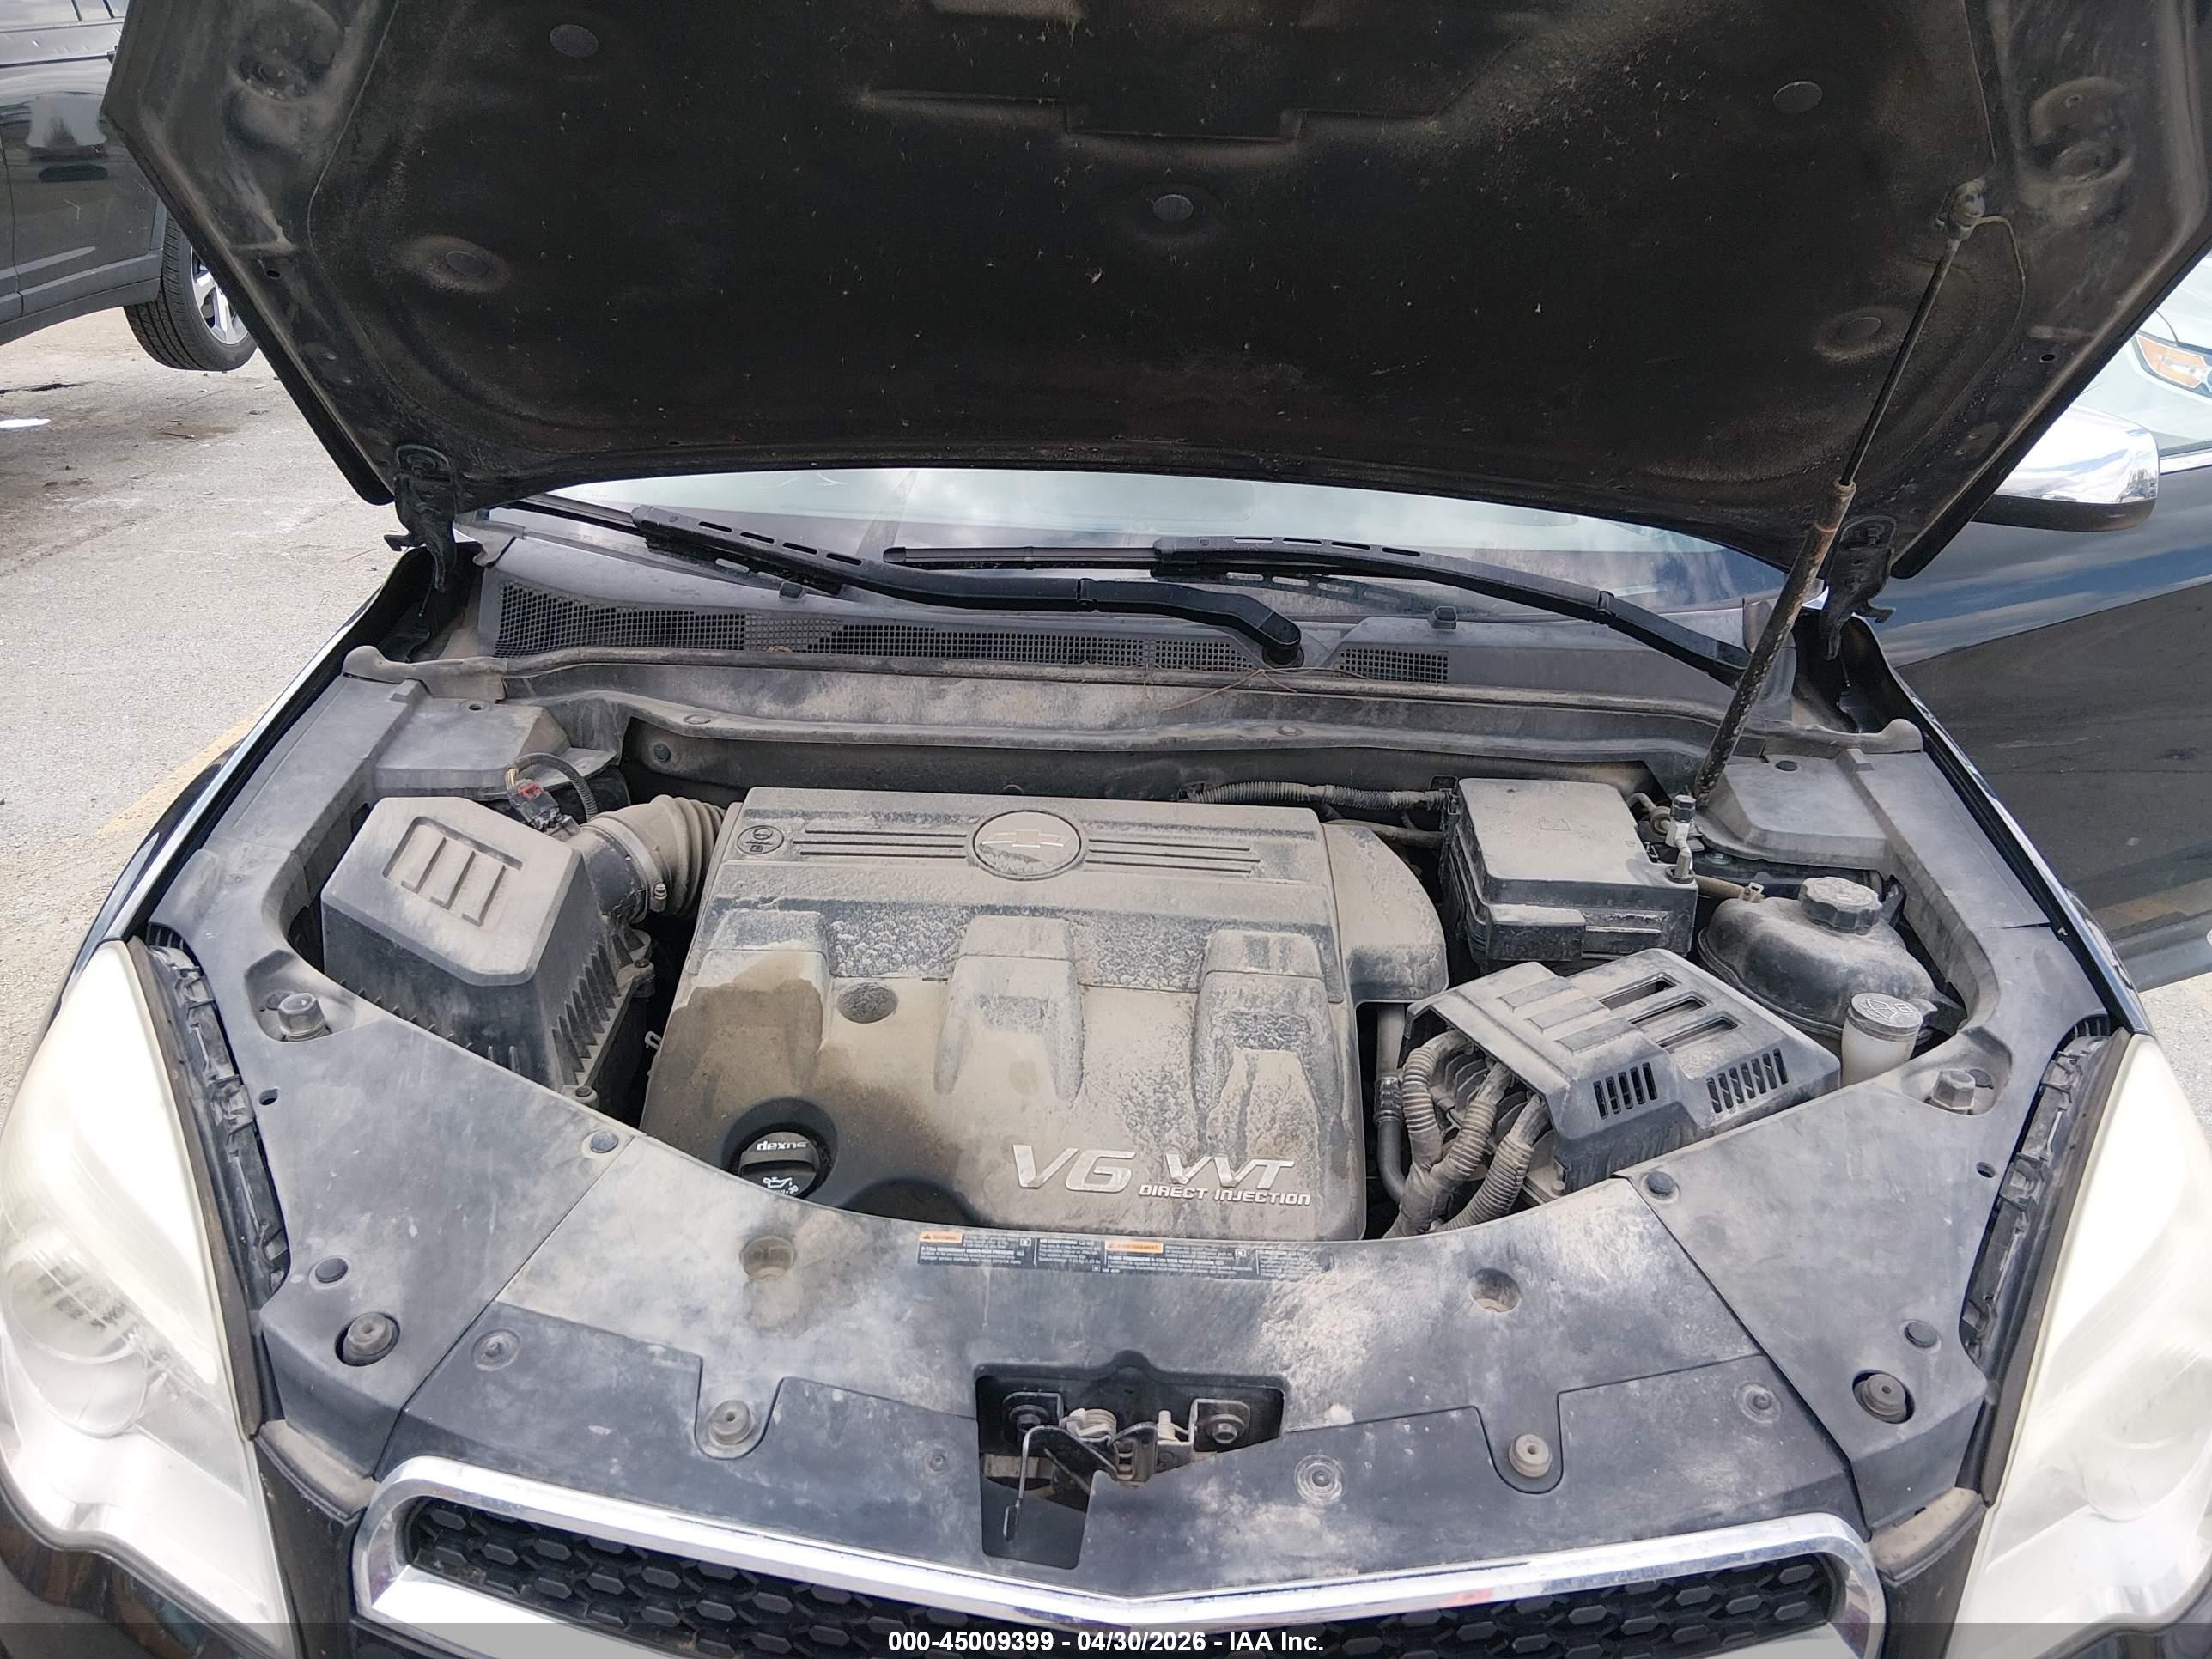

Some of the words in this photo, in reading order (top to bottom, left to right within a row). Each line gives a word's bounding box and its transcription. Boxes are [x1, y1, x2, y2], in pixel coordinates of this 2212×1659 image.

[1012, 1145, 1137, 1194] V6
[1164, 1153, 1295, 1190] VVT
[1139, 1184, 1208, 1200] DIRECT
[1214, 1188, 1310, 1206] INJECTION
